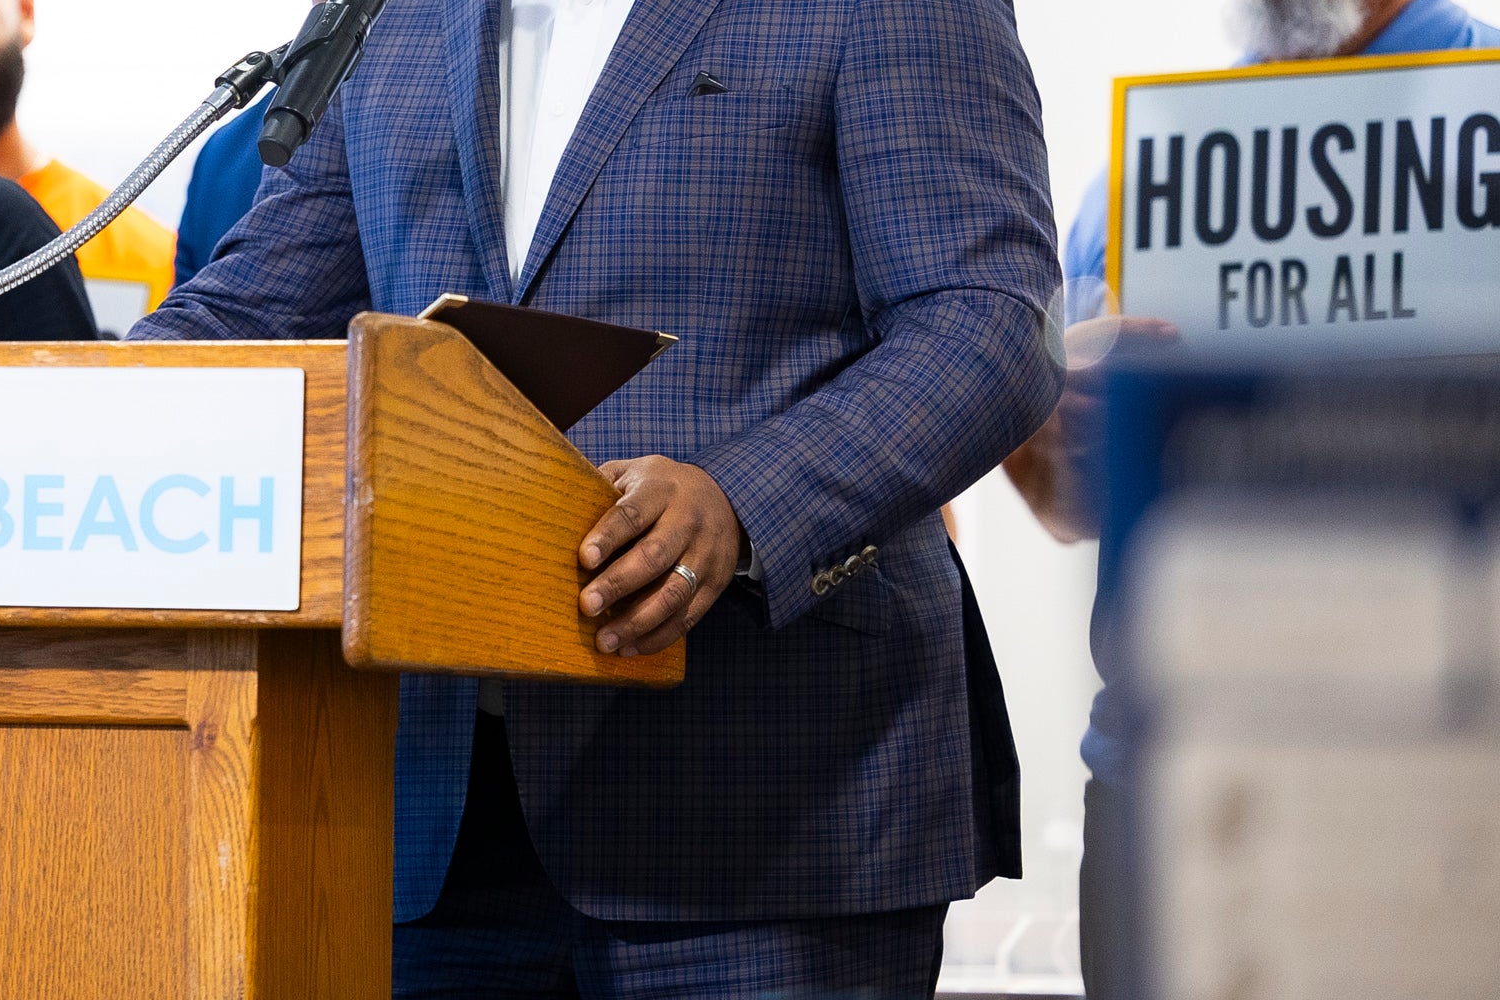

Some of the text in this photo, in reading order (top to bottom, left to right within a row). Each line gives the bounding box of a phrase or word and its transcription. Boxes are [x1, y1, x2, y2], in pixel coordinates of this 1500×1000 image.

[1135, 113, 1500, 249] HOUSING
[1218, 258, 1309, 330] FOR
[1326, 251, 1418, 324] ALL
